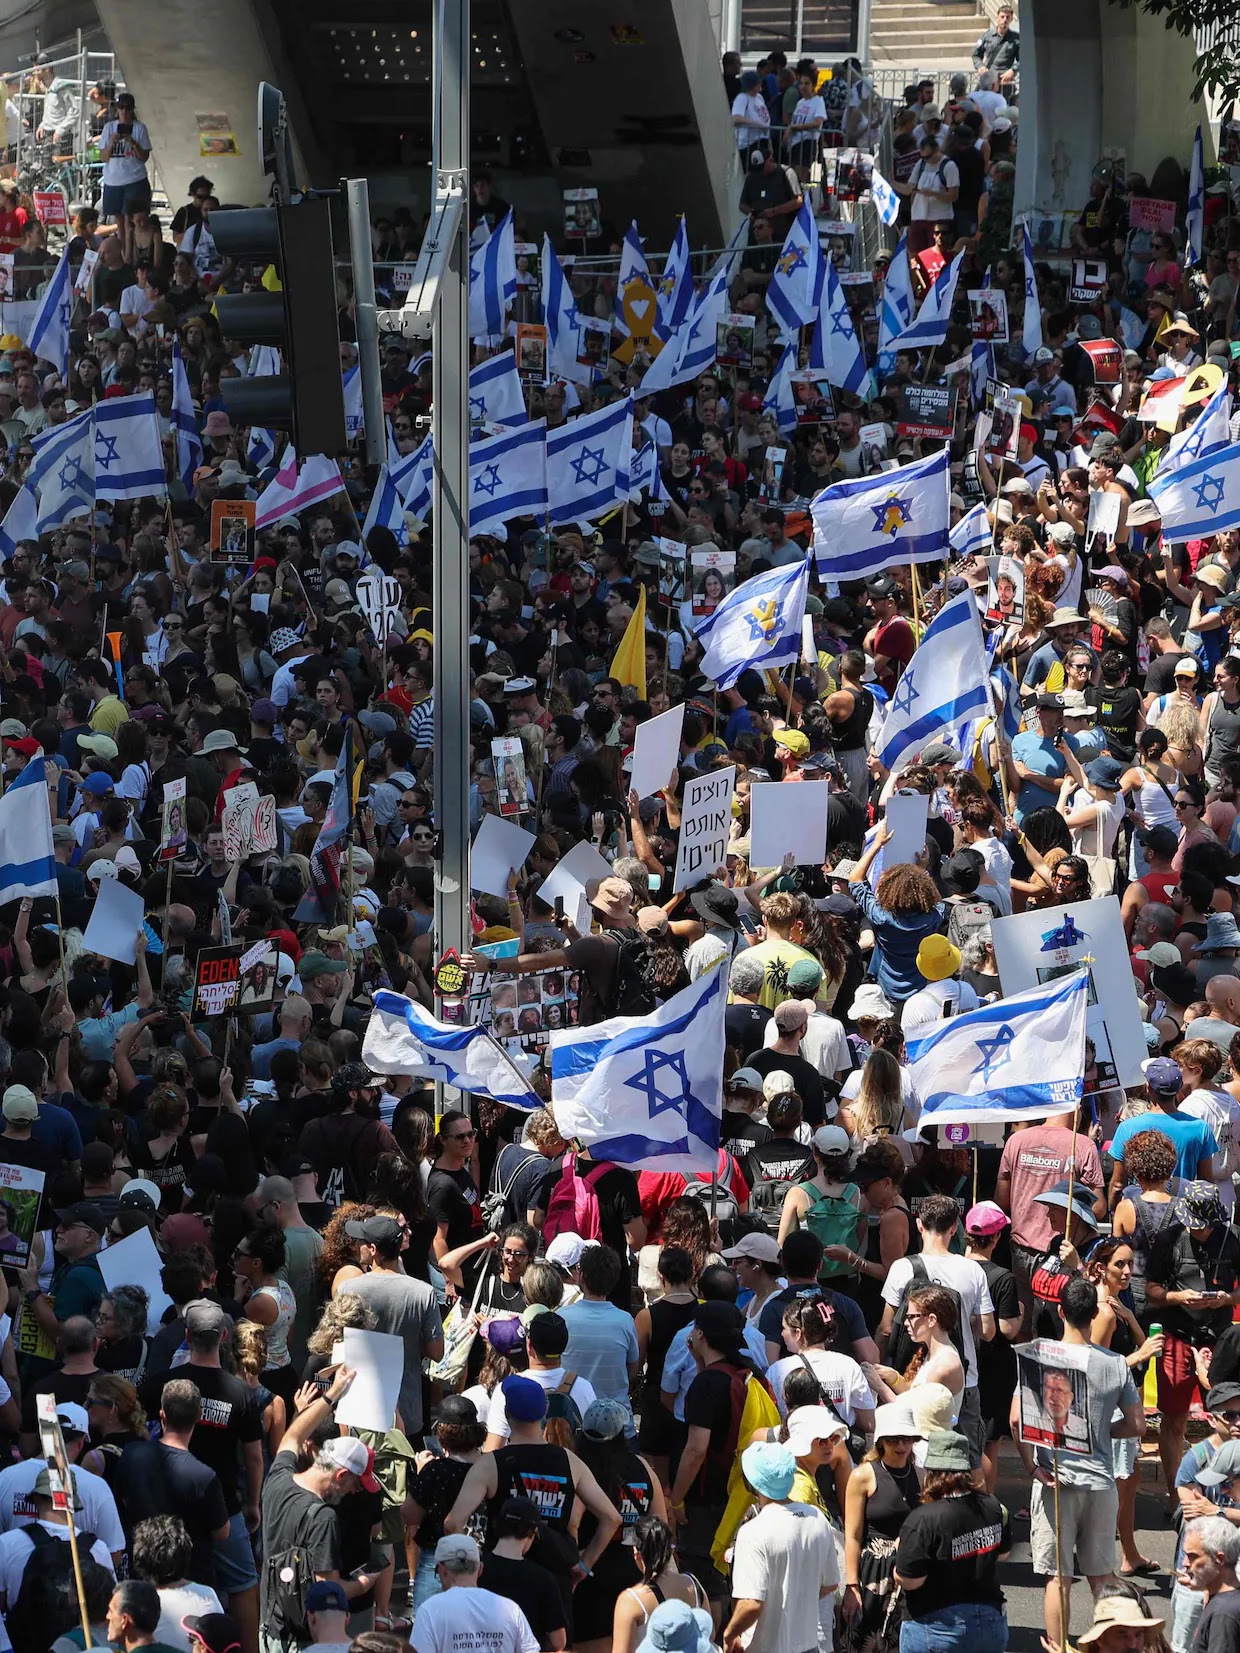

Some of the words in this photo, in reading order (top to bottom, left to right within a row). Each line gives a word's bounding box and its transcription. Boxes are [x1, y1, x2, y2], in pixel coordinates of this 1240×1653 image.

[1142, 215, 1162, 223] NOW
[691, 778, 728, 806] רוצים
[685, 809, 726, 837] אותם
[682, 839, 724, 872] חיים!
[200, 958, 239, 985] EDEN
[1020, 1153, 1061, 1169] Billabong
[206, 1398, 232, 1412] MISSING
[201, 1407, 230, 1425] FORUM
[951, 1538, 980, 1559] FAMILIES
